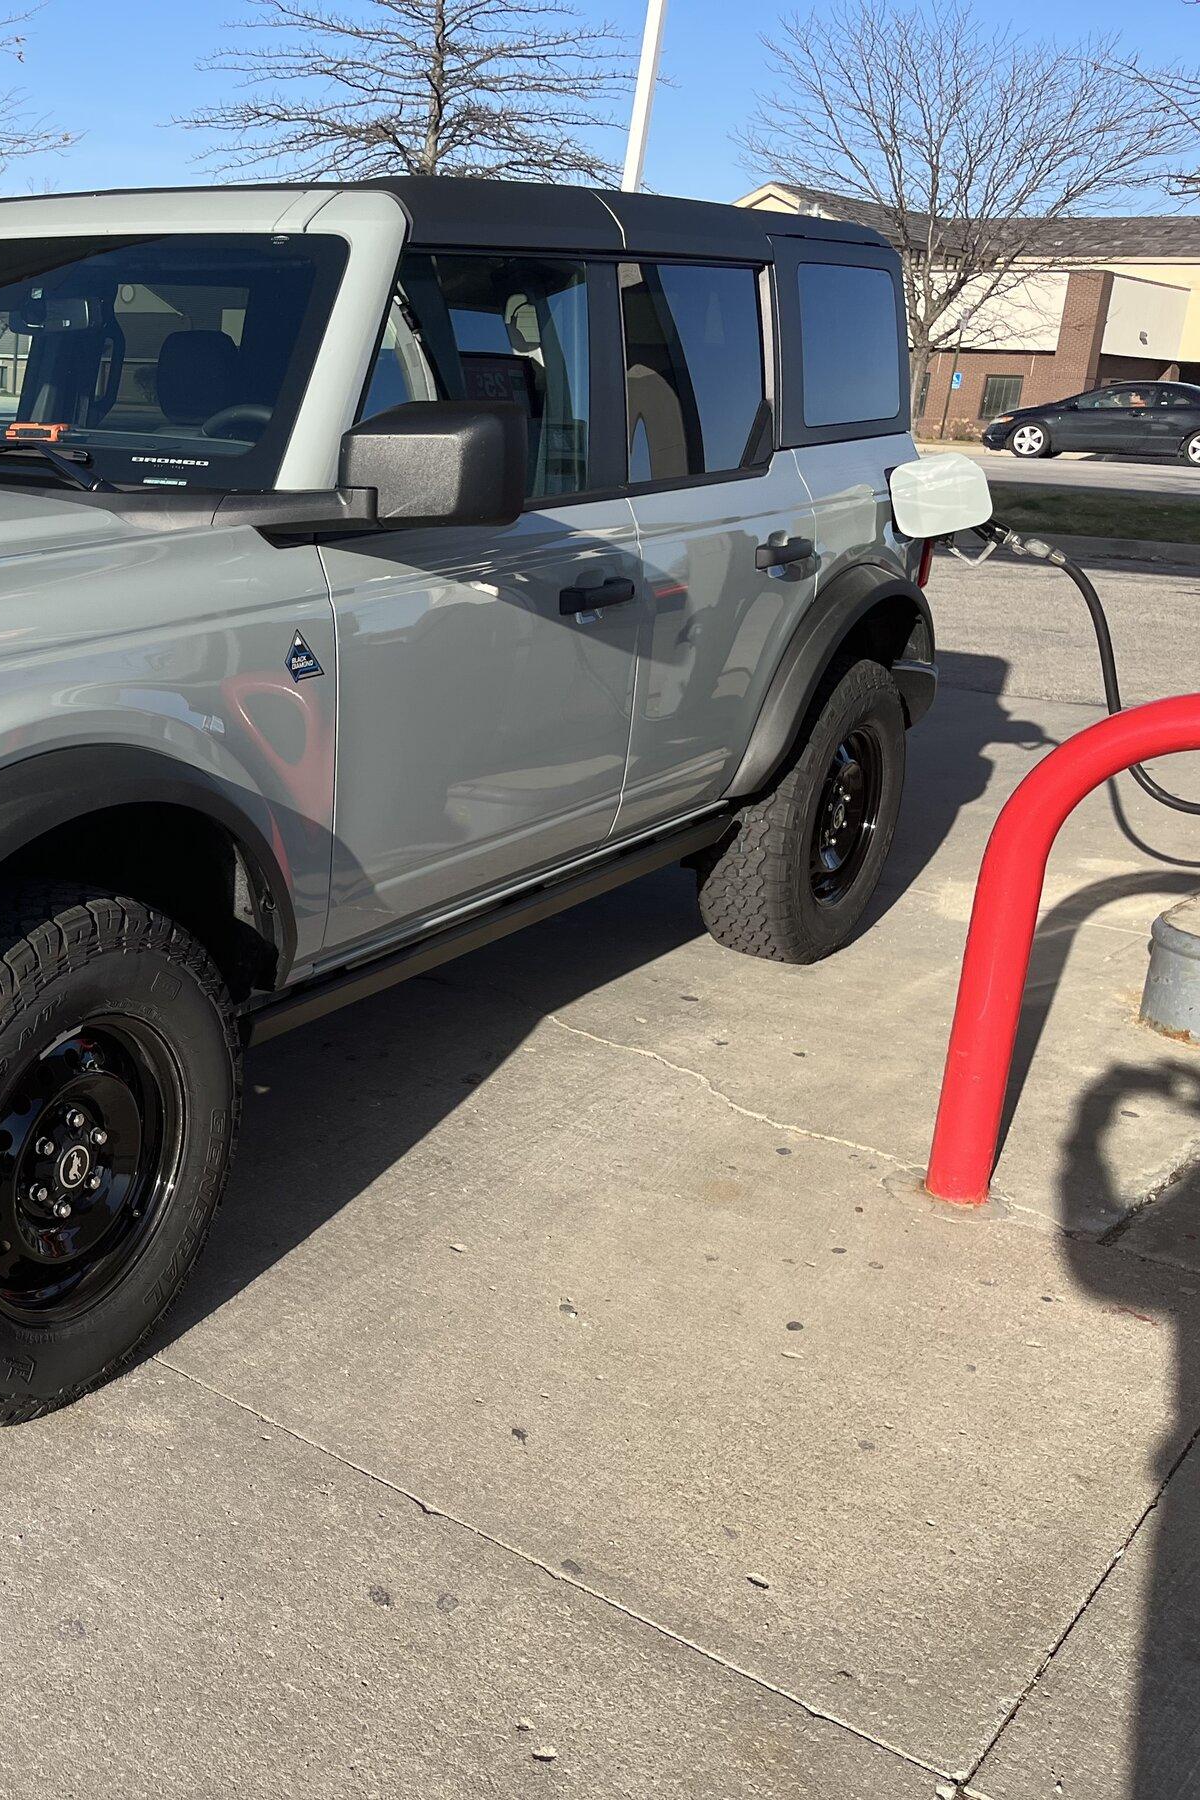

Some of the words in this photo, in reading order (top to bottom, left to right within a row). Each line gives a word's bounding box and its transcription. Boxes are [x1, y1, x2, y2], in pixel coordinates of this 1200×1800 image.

[131, 456, 209, 467] BRONCO
[291, 655, 307, 664] BLACK
[291, 659, 314, 670] DIAMOND
[143, 1107, 228, 1306] GENERAL
